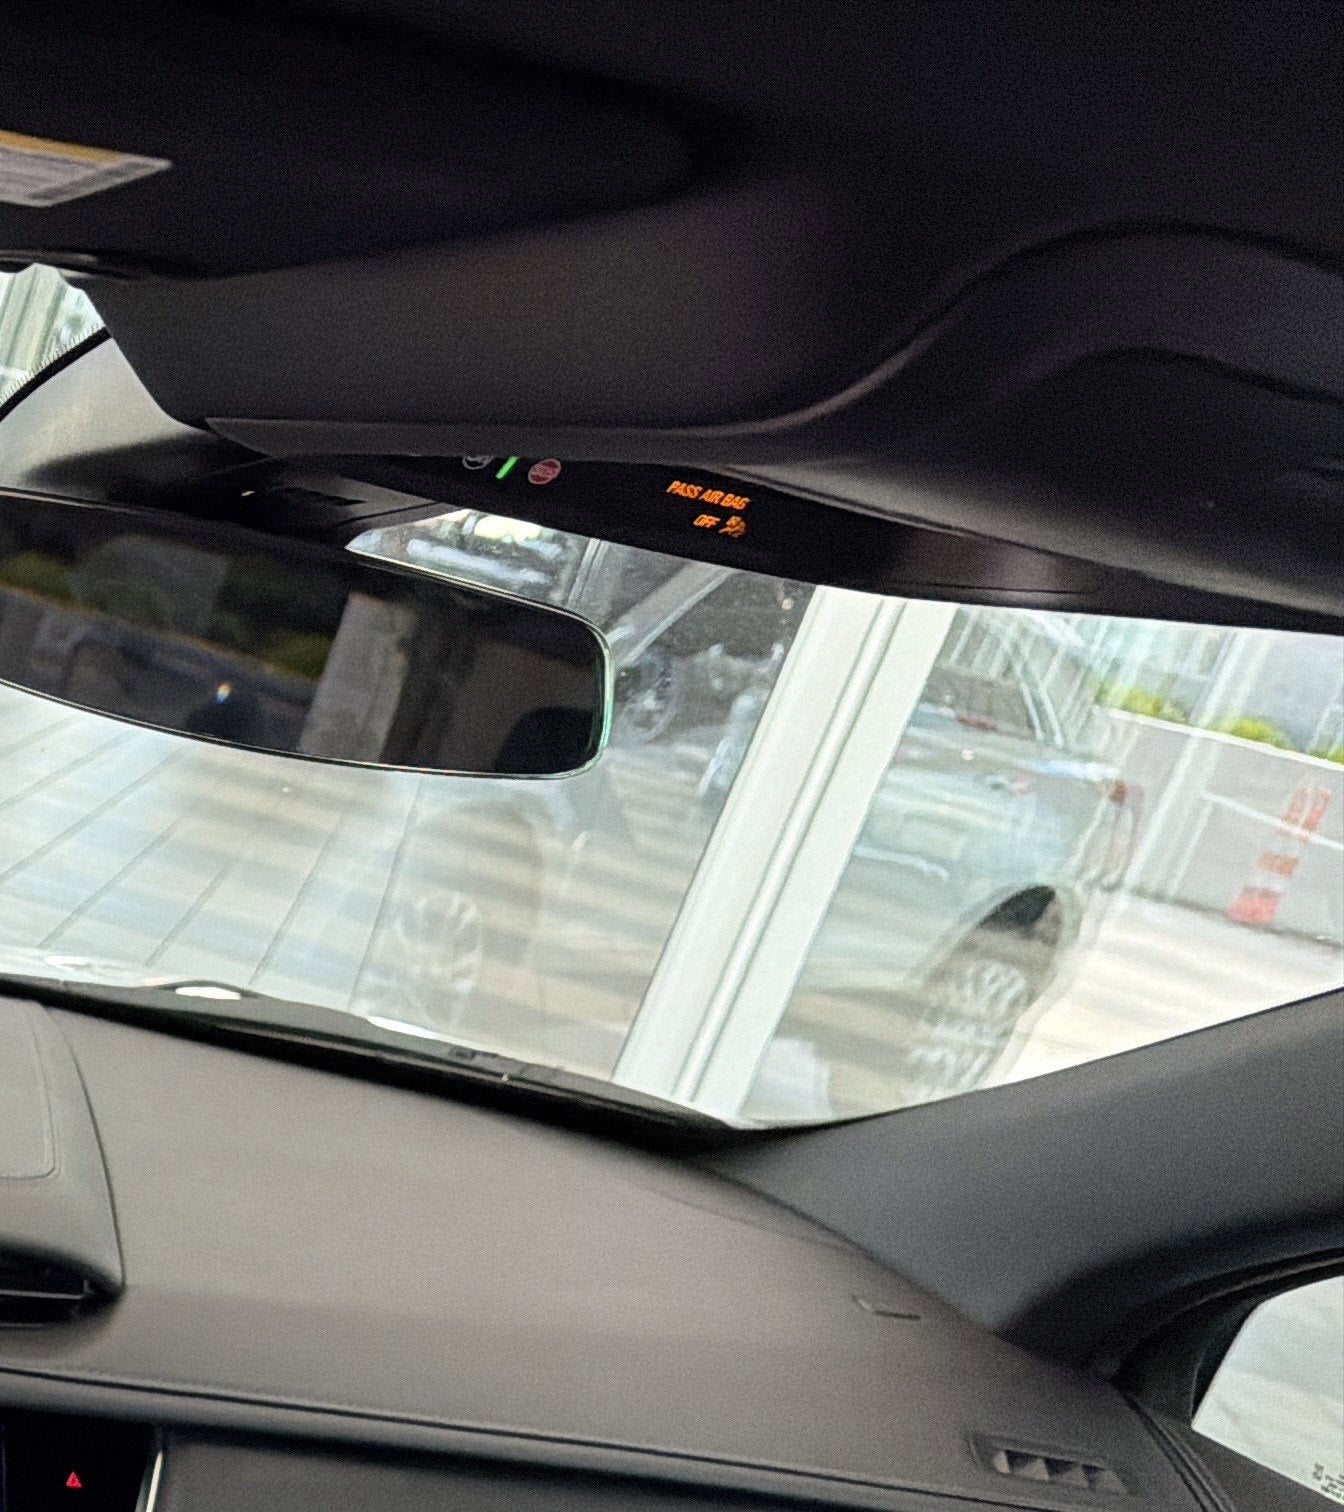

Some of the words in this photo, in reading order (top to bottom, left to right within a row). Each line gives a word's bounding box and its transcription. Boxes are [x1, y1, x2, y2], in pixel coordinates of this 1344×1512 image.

[666, 480, 703, 499] PASS
[699, 488, 727, 505] AIR
[720, 492, 751, 510] BAG
[693, 514, 721, 529] OFF
